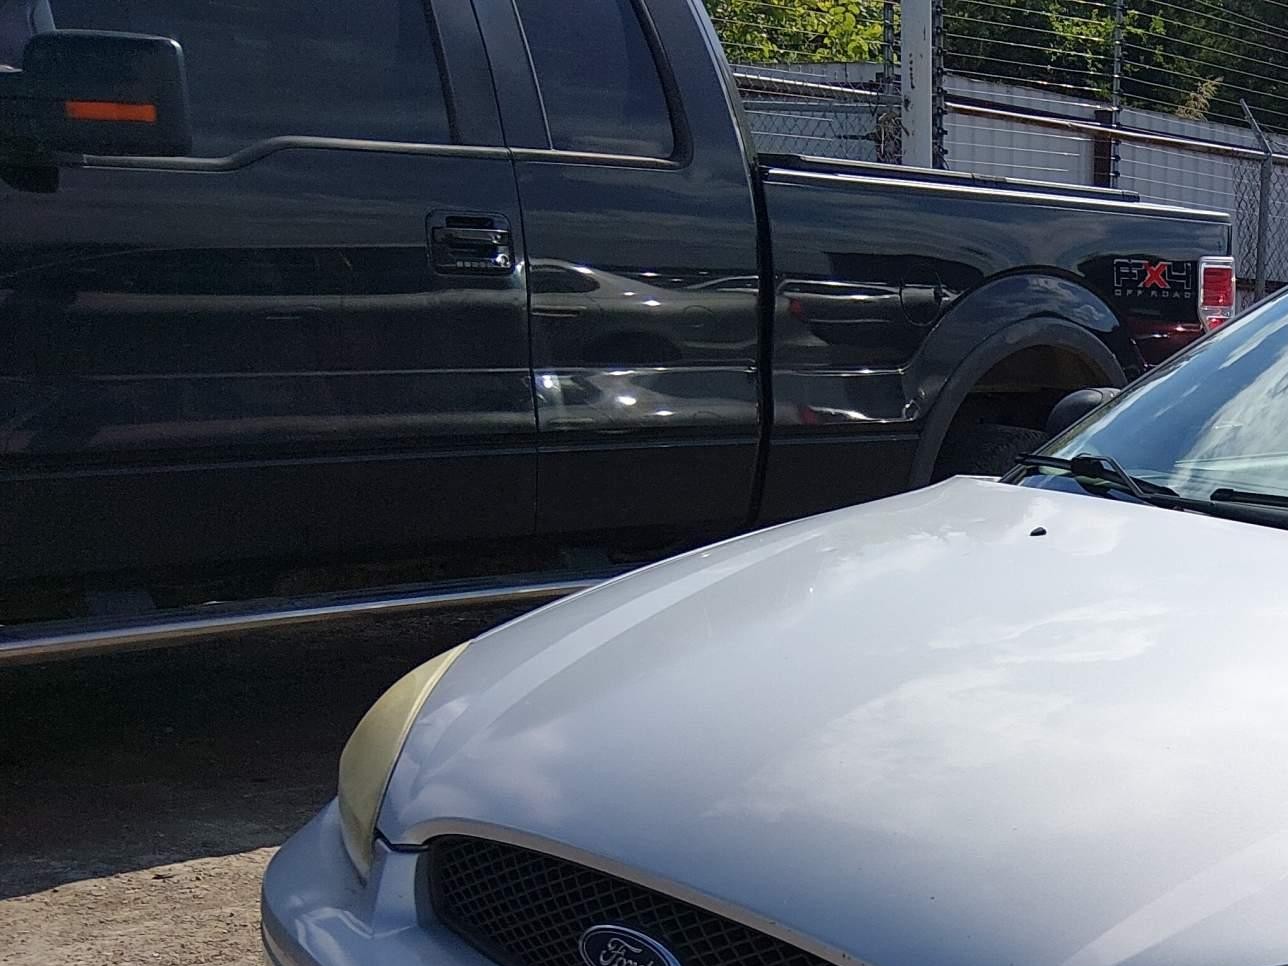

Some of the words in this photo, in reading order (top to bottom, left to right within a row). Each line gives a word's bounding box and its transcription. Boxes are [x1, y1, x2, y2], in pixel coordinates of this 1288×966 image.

[1113, 258, 1192, 290] FX4
[1114, 289, 1145, 297] OFF
[1150, 290, 1191, 298] ROAD
